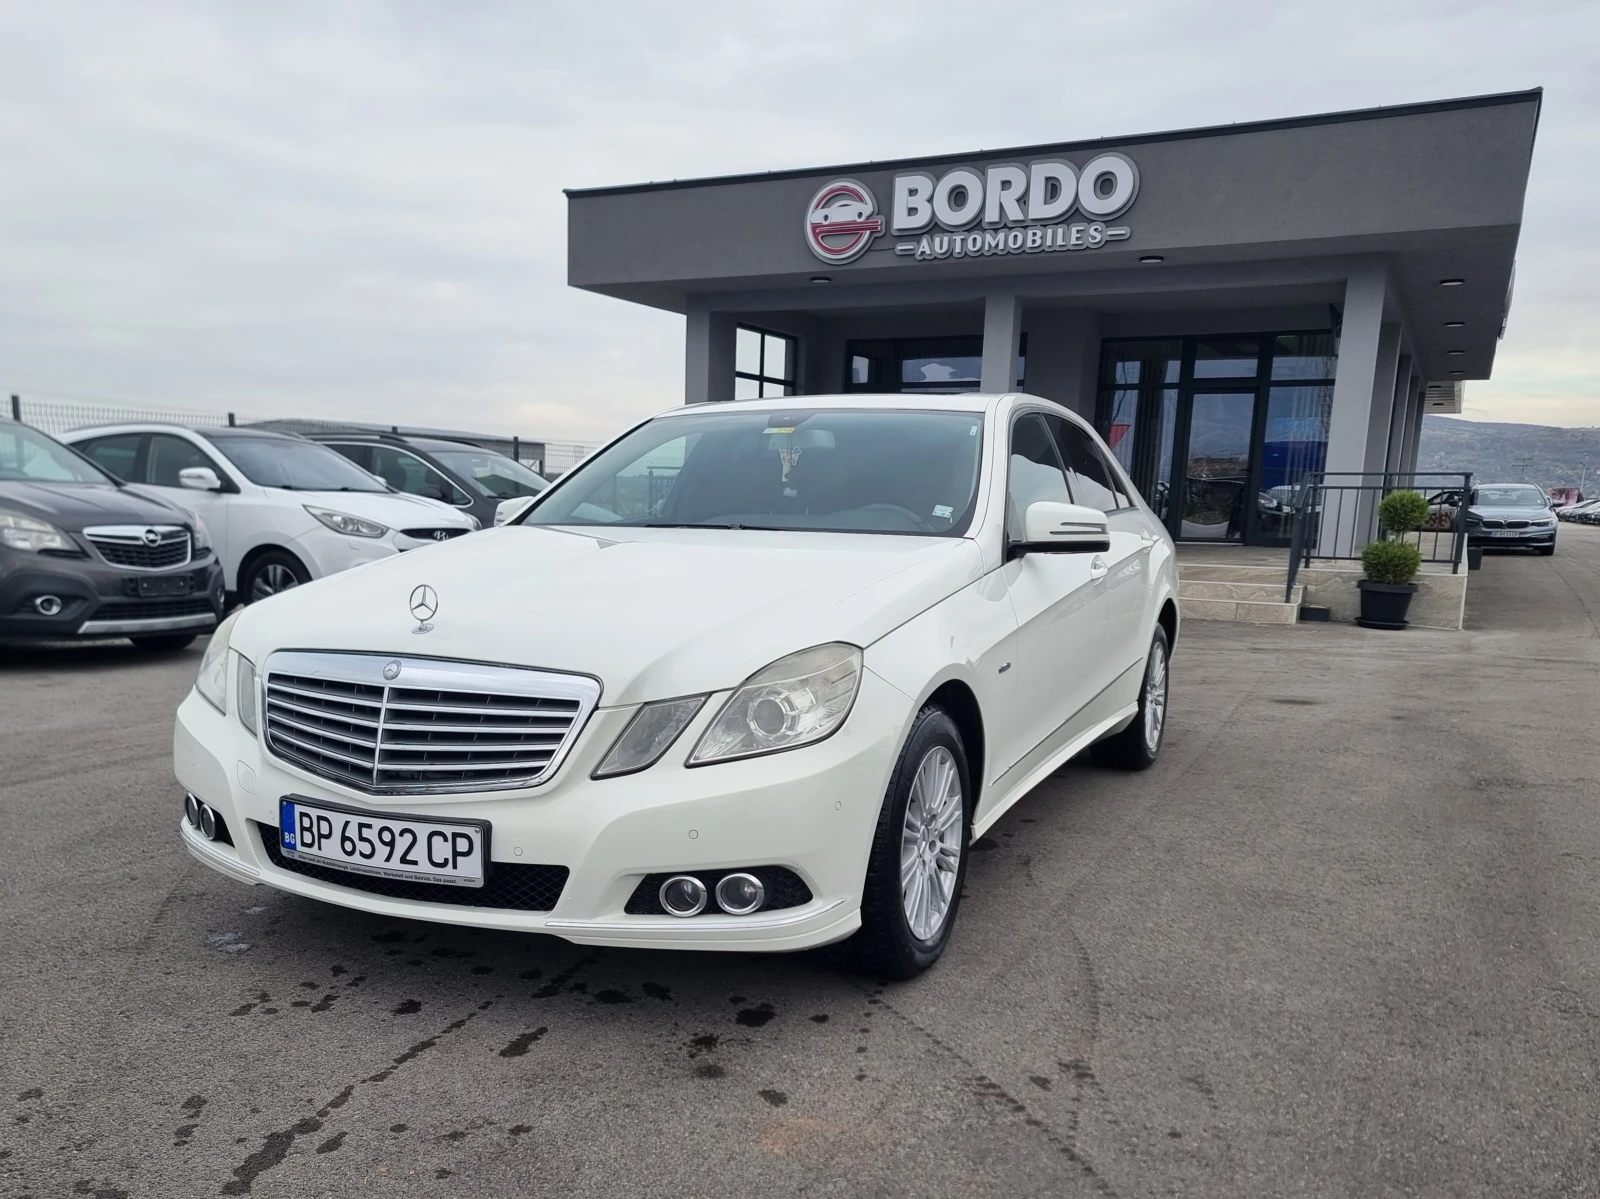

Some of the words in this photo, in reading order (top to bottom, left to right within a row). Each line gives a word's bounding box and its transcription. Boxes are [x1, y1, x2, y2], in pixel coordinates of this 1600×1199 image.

[893, 156, 1134, 230] BORDO
[917, 225, 1103, 256] AUTOMOBILES
[284, 831, 296, 845] BG
[299, 811, 333, 851] BP
[340, 820, 419, 866] 6592
[426, 830, 474, 870] CP
